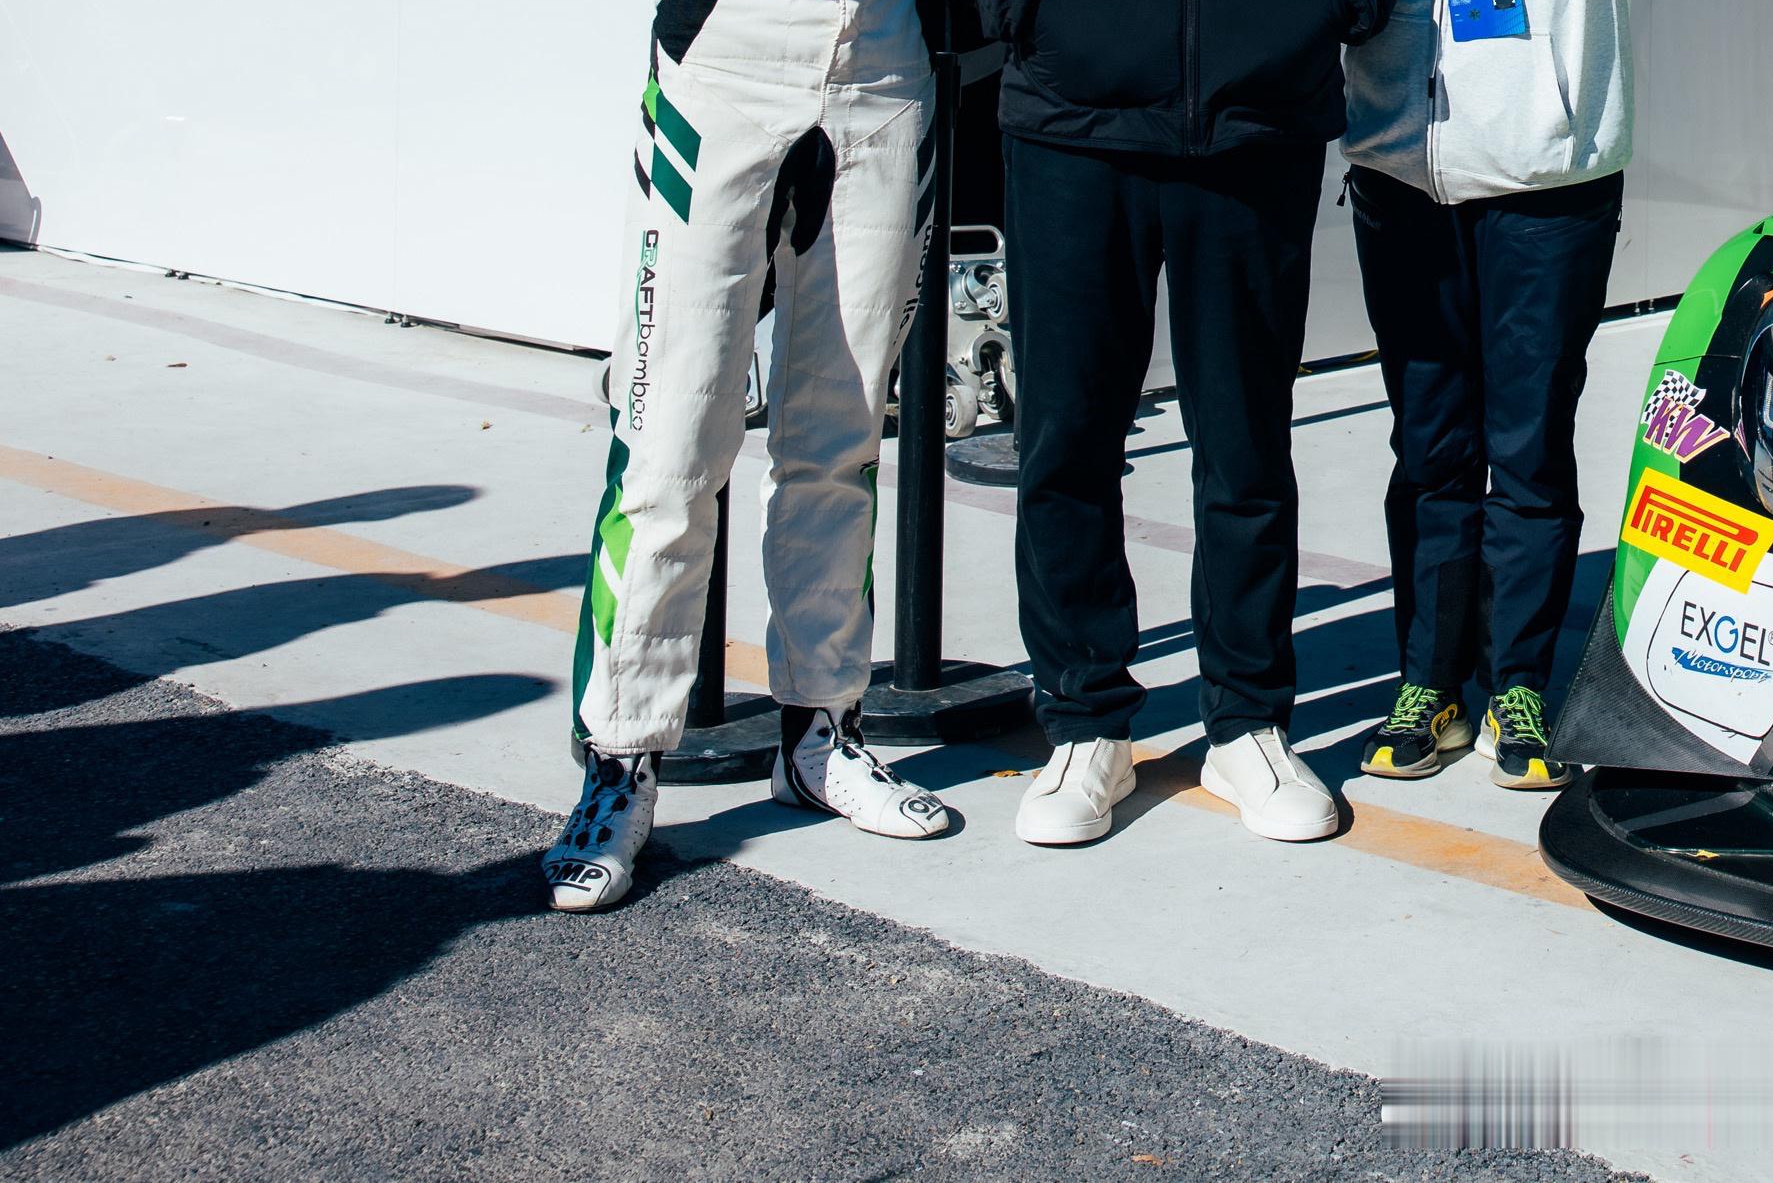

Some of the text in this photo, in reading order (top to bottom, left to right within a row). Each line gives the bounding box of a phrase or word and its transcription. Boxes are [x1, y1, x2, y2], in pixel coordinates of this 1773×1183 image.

[1643, 395, 1731, 463] KW
[1631, 485, 1759, 573] PIRELLI
[544, 862, 604, 884] OMP
